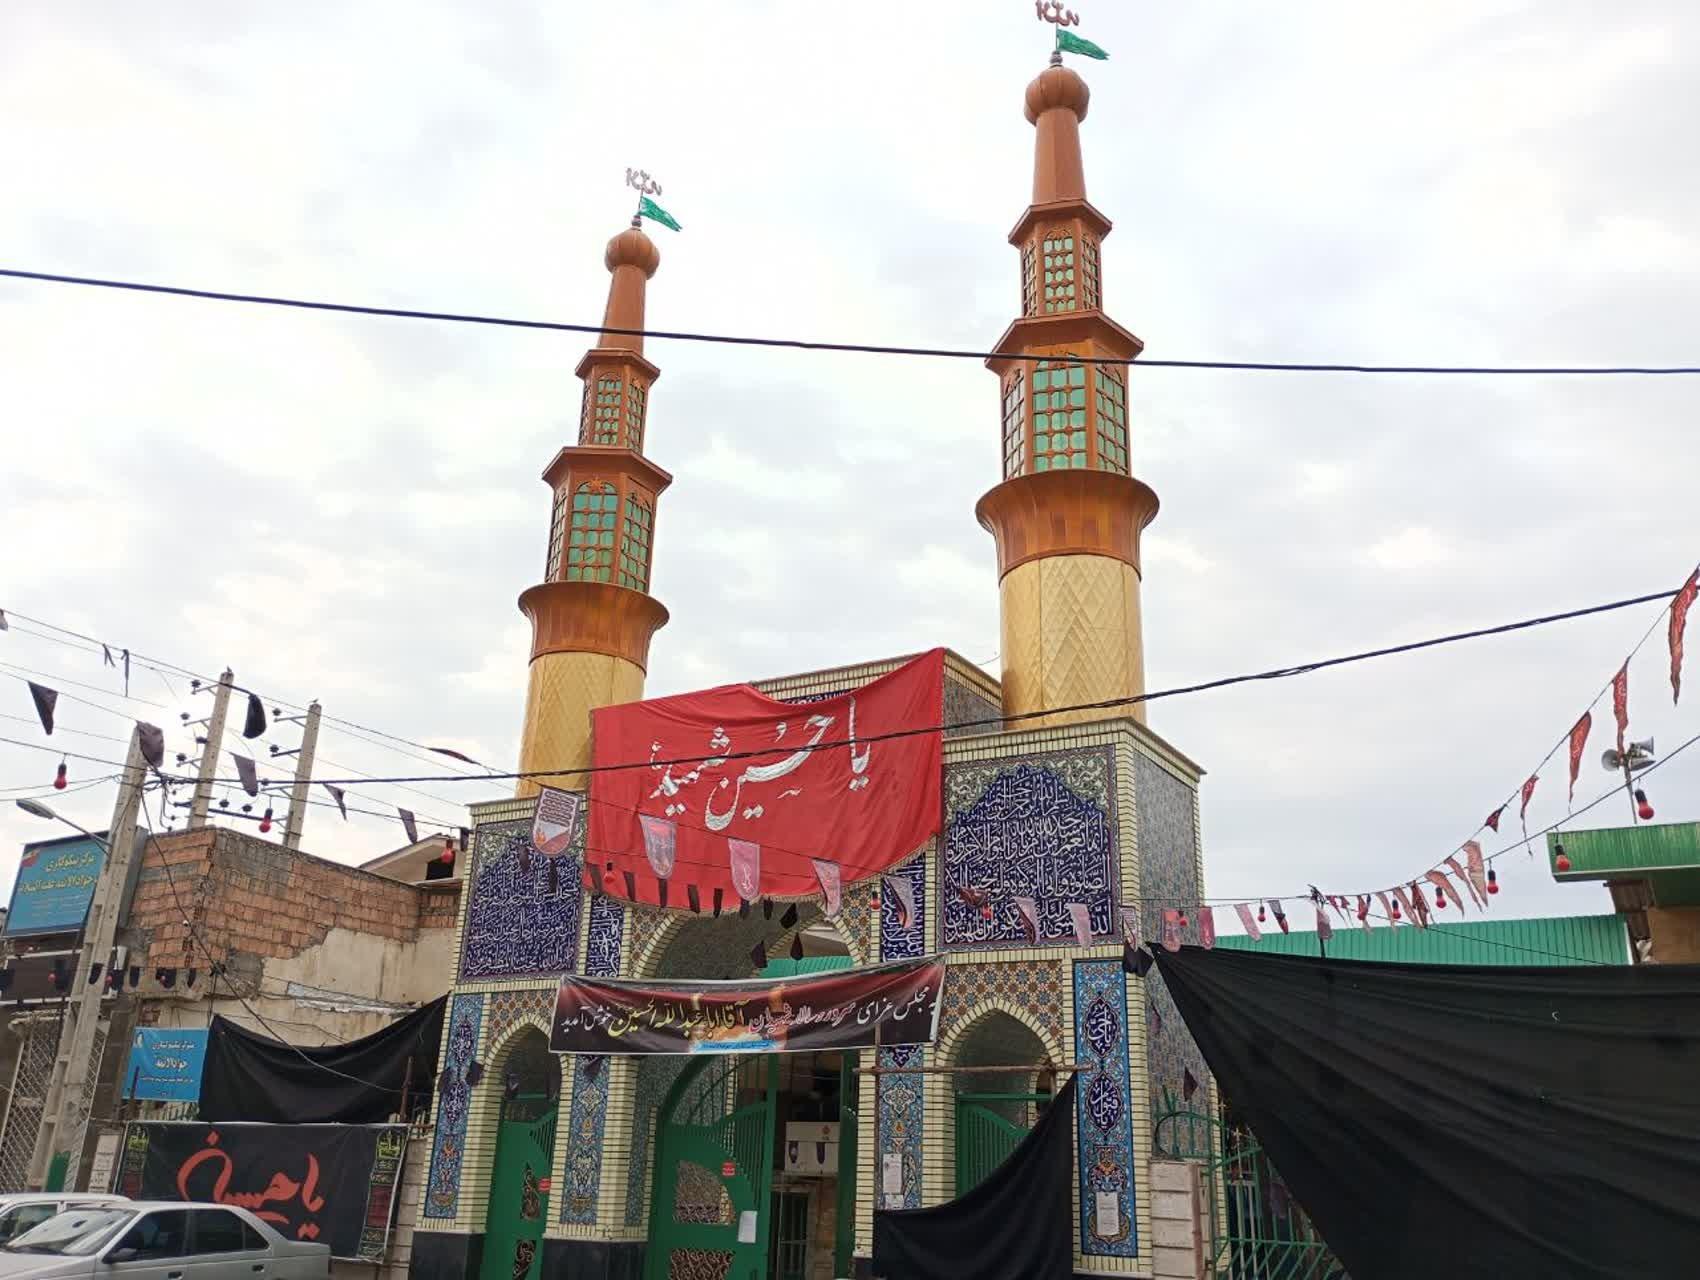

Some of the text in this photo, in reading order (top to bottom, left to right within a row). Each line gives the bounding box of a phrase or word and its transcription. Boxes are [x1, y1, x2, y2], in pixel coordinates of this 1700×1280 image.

[848, 696, 871, 792] یا
[561, 1005, 591, 1033] آمدید
[584, 1004, 612, 1031] خوش
[857, 997, 894, 1024] عزای
[893, 986, 930, 1021] مجلس
[297, 1152, 325, 1239] یا
